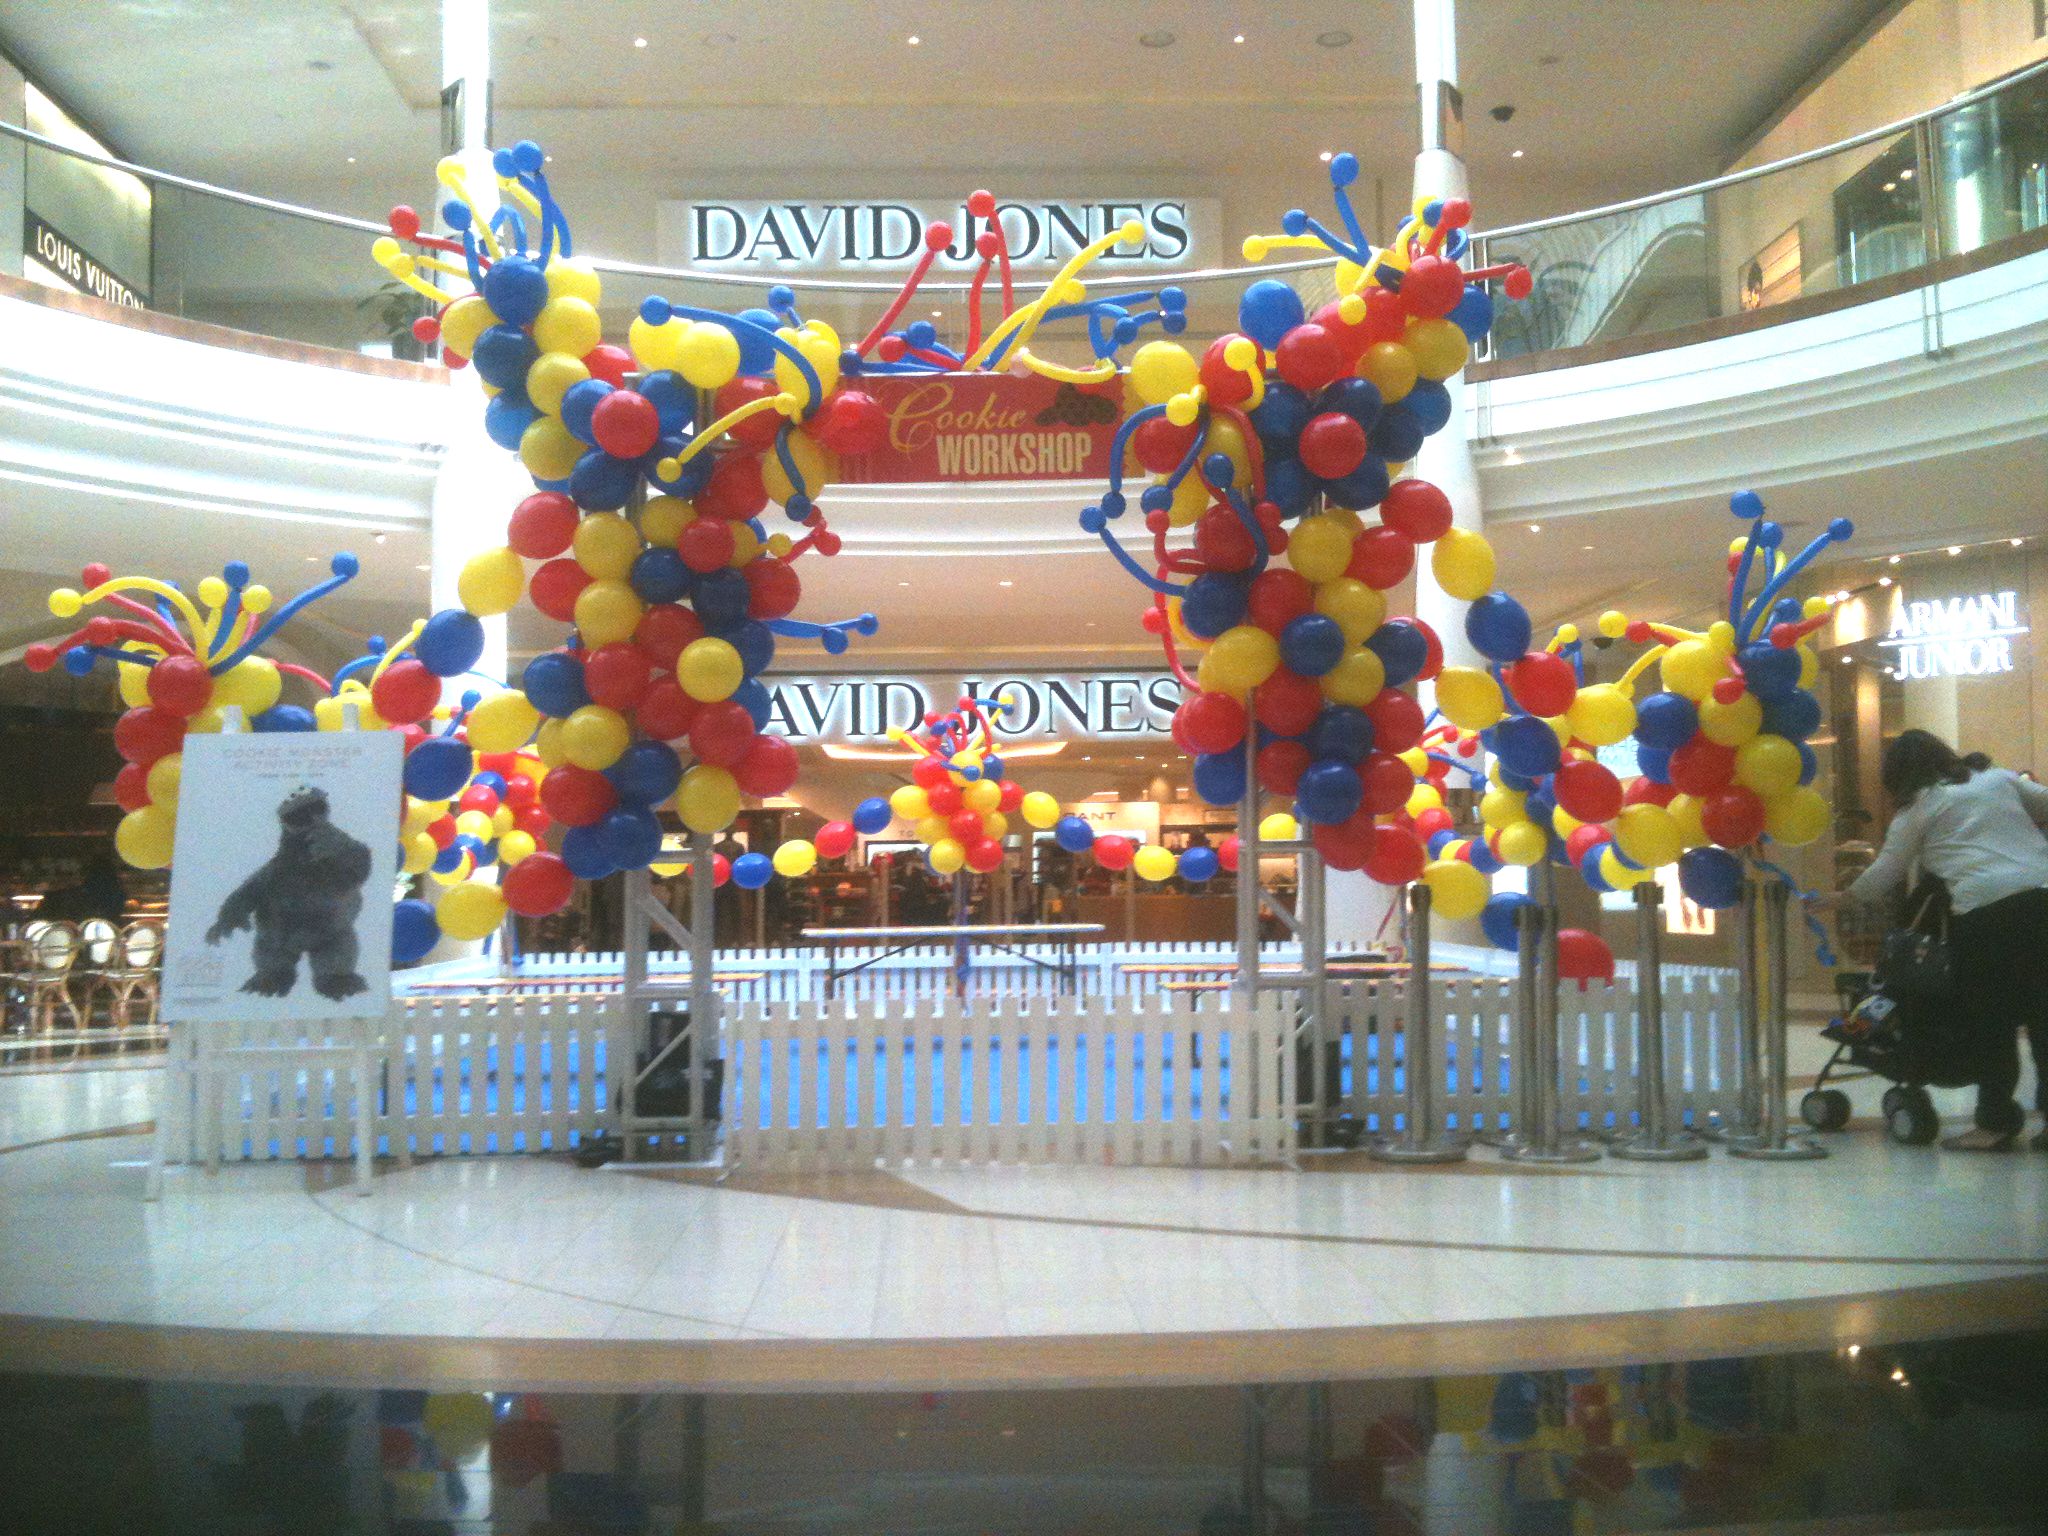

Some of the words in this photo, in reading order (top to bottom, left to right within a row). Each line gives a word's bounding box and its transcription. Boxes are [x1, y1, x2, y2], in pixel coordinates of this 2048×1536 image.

[37, 225, 81, 281] LOUIS
[691, 204, 922, 261] DAVID
[945, 202, 1188, 261] JONES
[885, 381, 1027, 453] Cookie
[936, 431, 1092, 476] WORKSHOP
[1888, 592, 2018, 638] ARMANI
[1893, 638, 2014, 681] JUNIOR
[755, 682, 925, 736] AVID
[956, 677, 1181, 736] JONES
